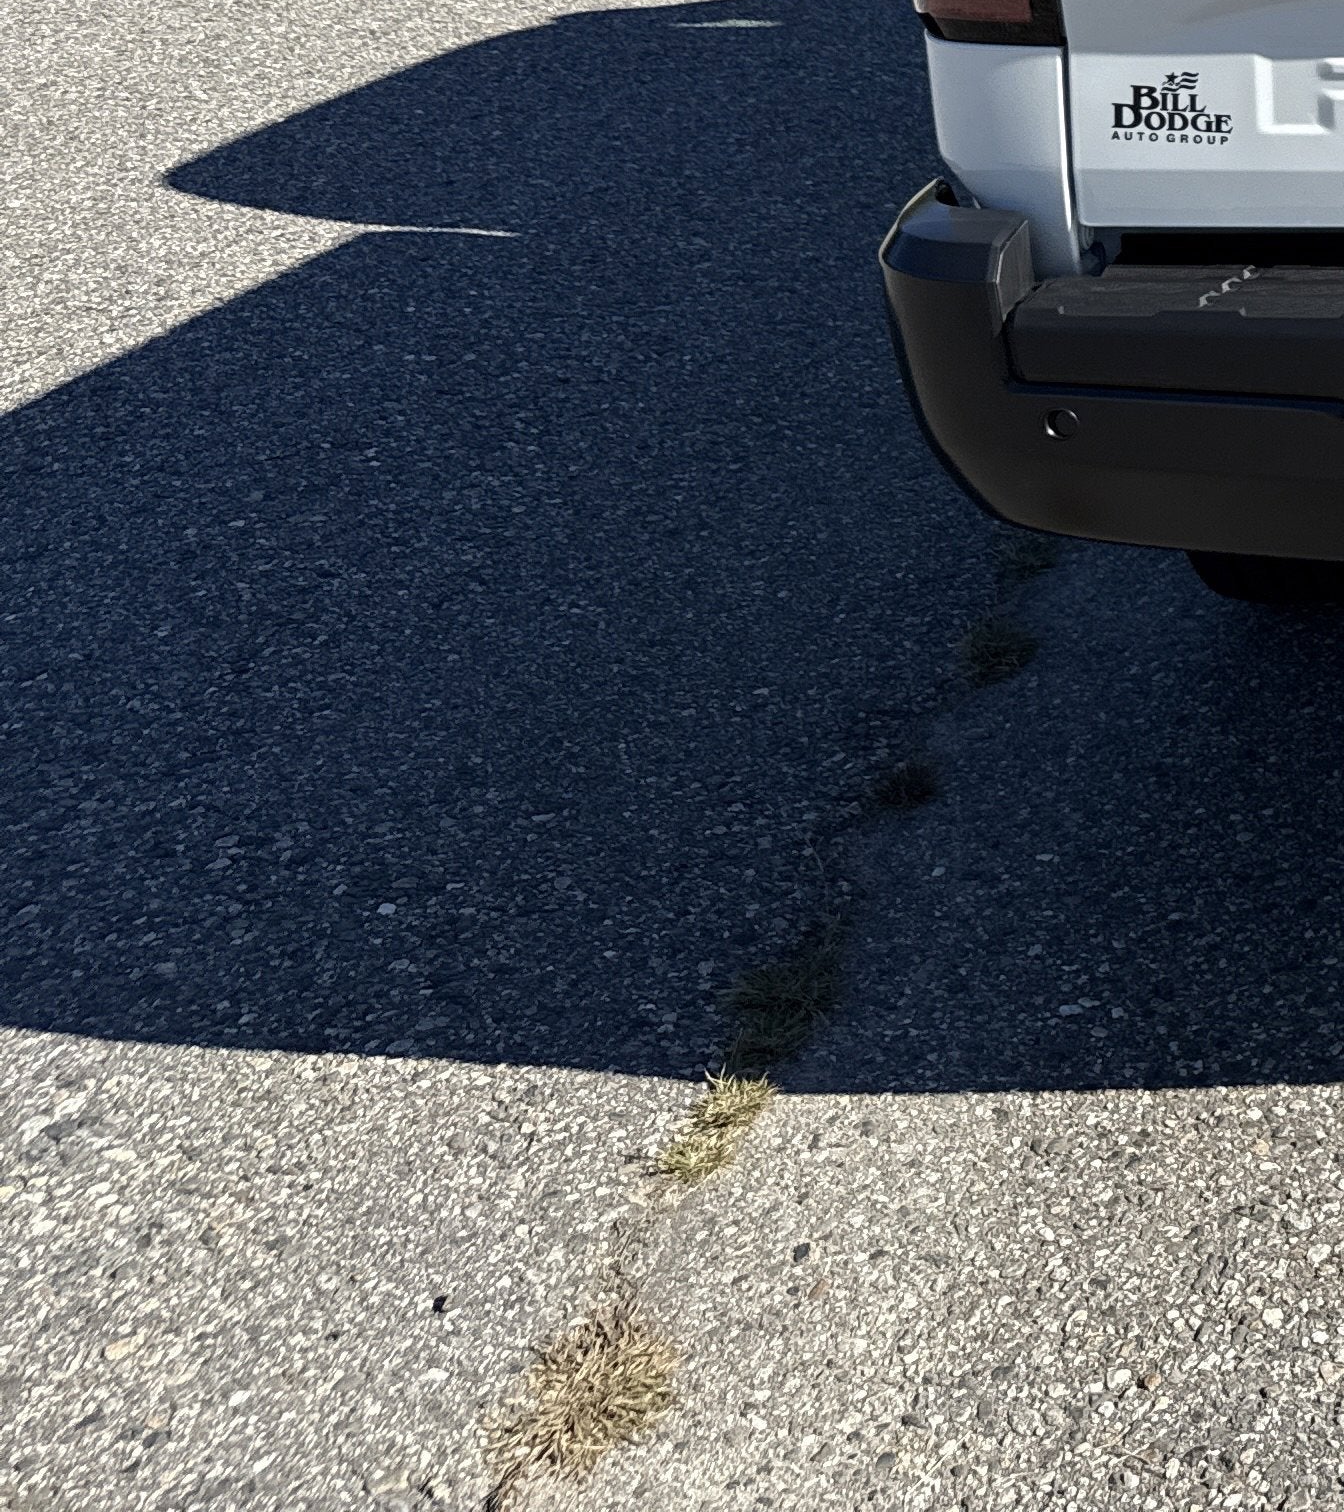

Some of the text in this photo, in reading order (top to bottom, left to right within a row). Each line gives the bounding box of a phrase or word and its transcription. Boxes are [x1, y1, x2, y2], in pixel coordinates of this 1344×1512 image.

[1130, 84, 1207, 113] BILL
[1111, 102, 1234, 134] DODGE
[1111, 131, 1229, 145] AUTO GROUP
